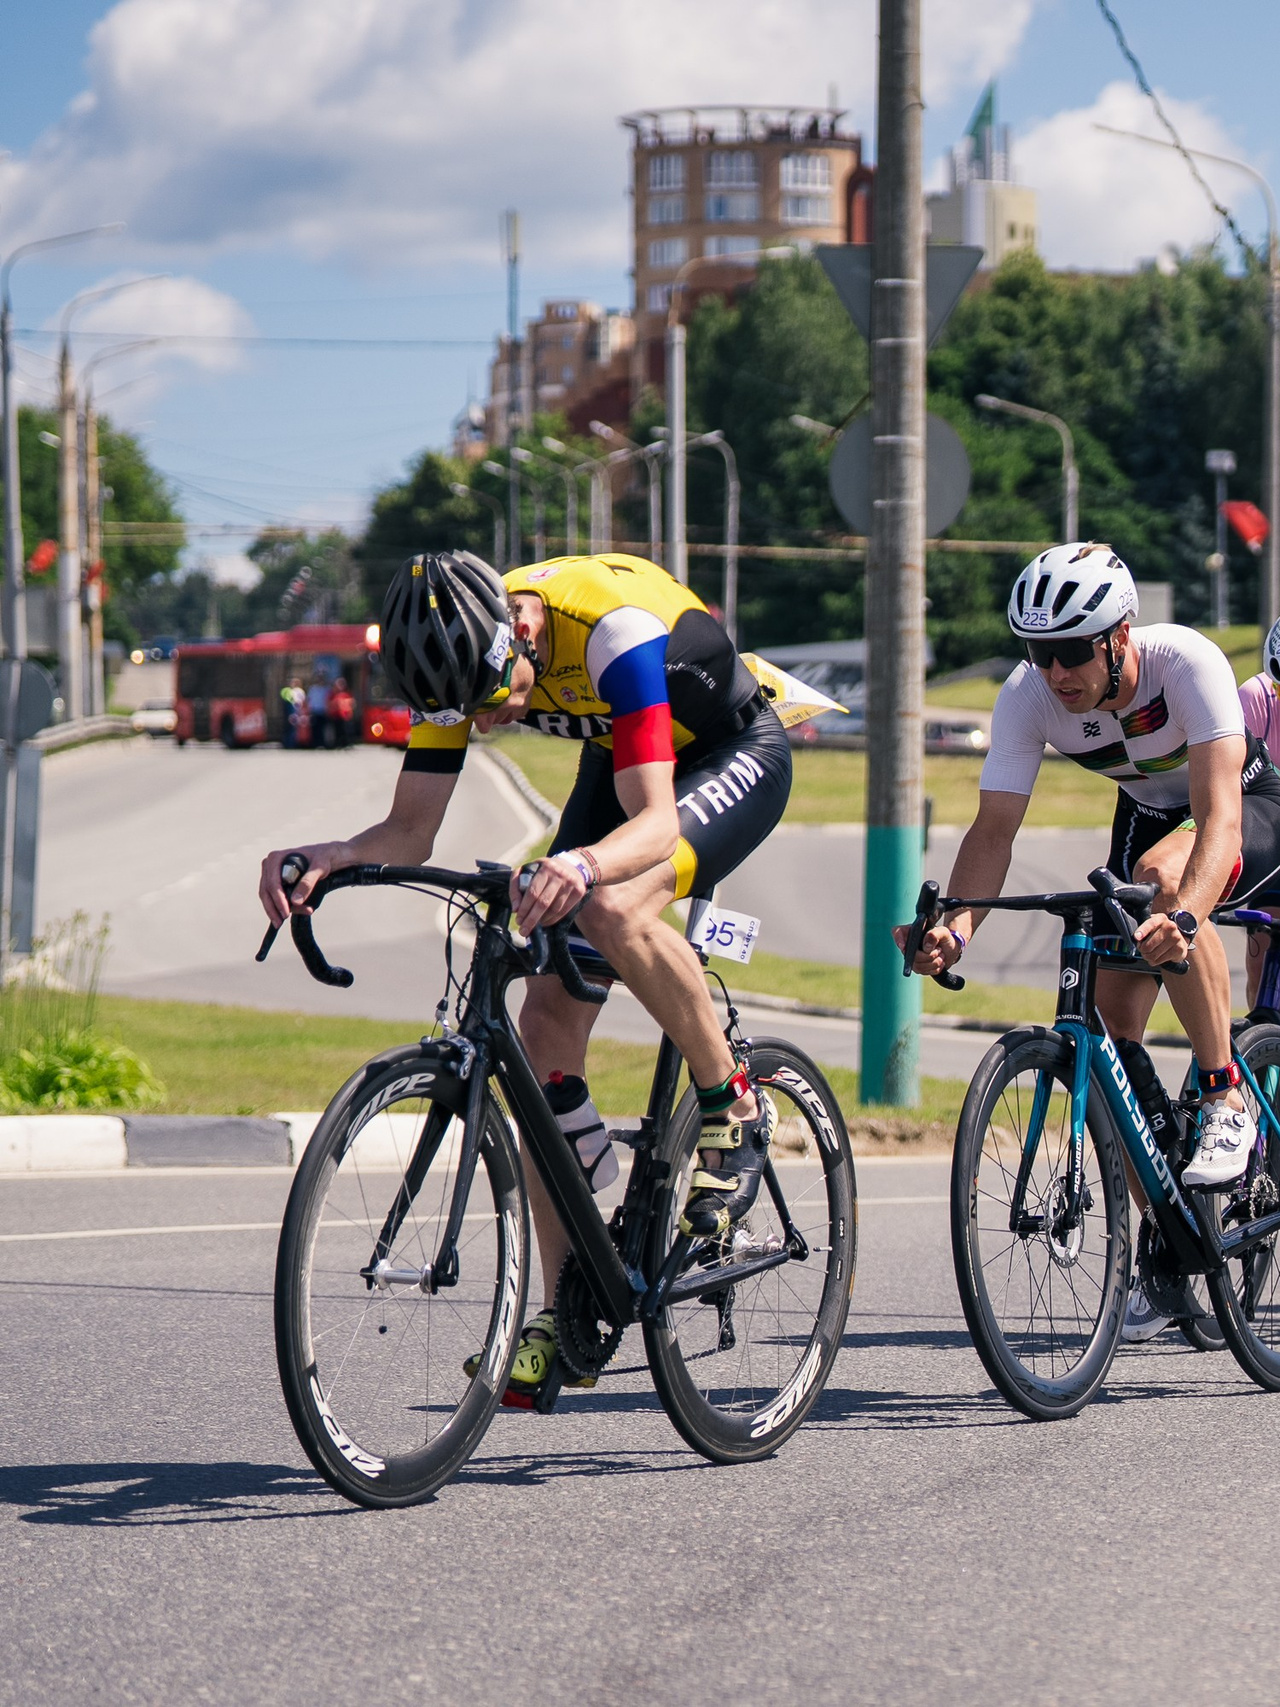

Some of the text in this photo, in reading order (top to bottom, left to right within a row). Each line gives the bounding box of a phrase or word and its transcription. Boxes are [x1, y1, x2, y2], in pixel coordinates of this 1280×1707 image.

[1022, 612, 1049, 627] 225
[1118, 589, 1134, 608] 225
[493, 634, 511, 663] 195
[429, 713, 458, 726] 95
[675, 751, 765, 826] TRIM
[343, 1072, 437, 1154] ZIPP
[775, 1065, 840, 1154] ZIPP
[1100, 1033, 1179, 1205] POLYGON
[1073, 1132, 1083, 1195] POLYGON
[1105, 1138, 1129, 1338] NOVATEC
[309, 1375, 386, 1479] ZIPP
[750, 1341, 823, 1439] ZIPP
